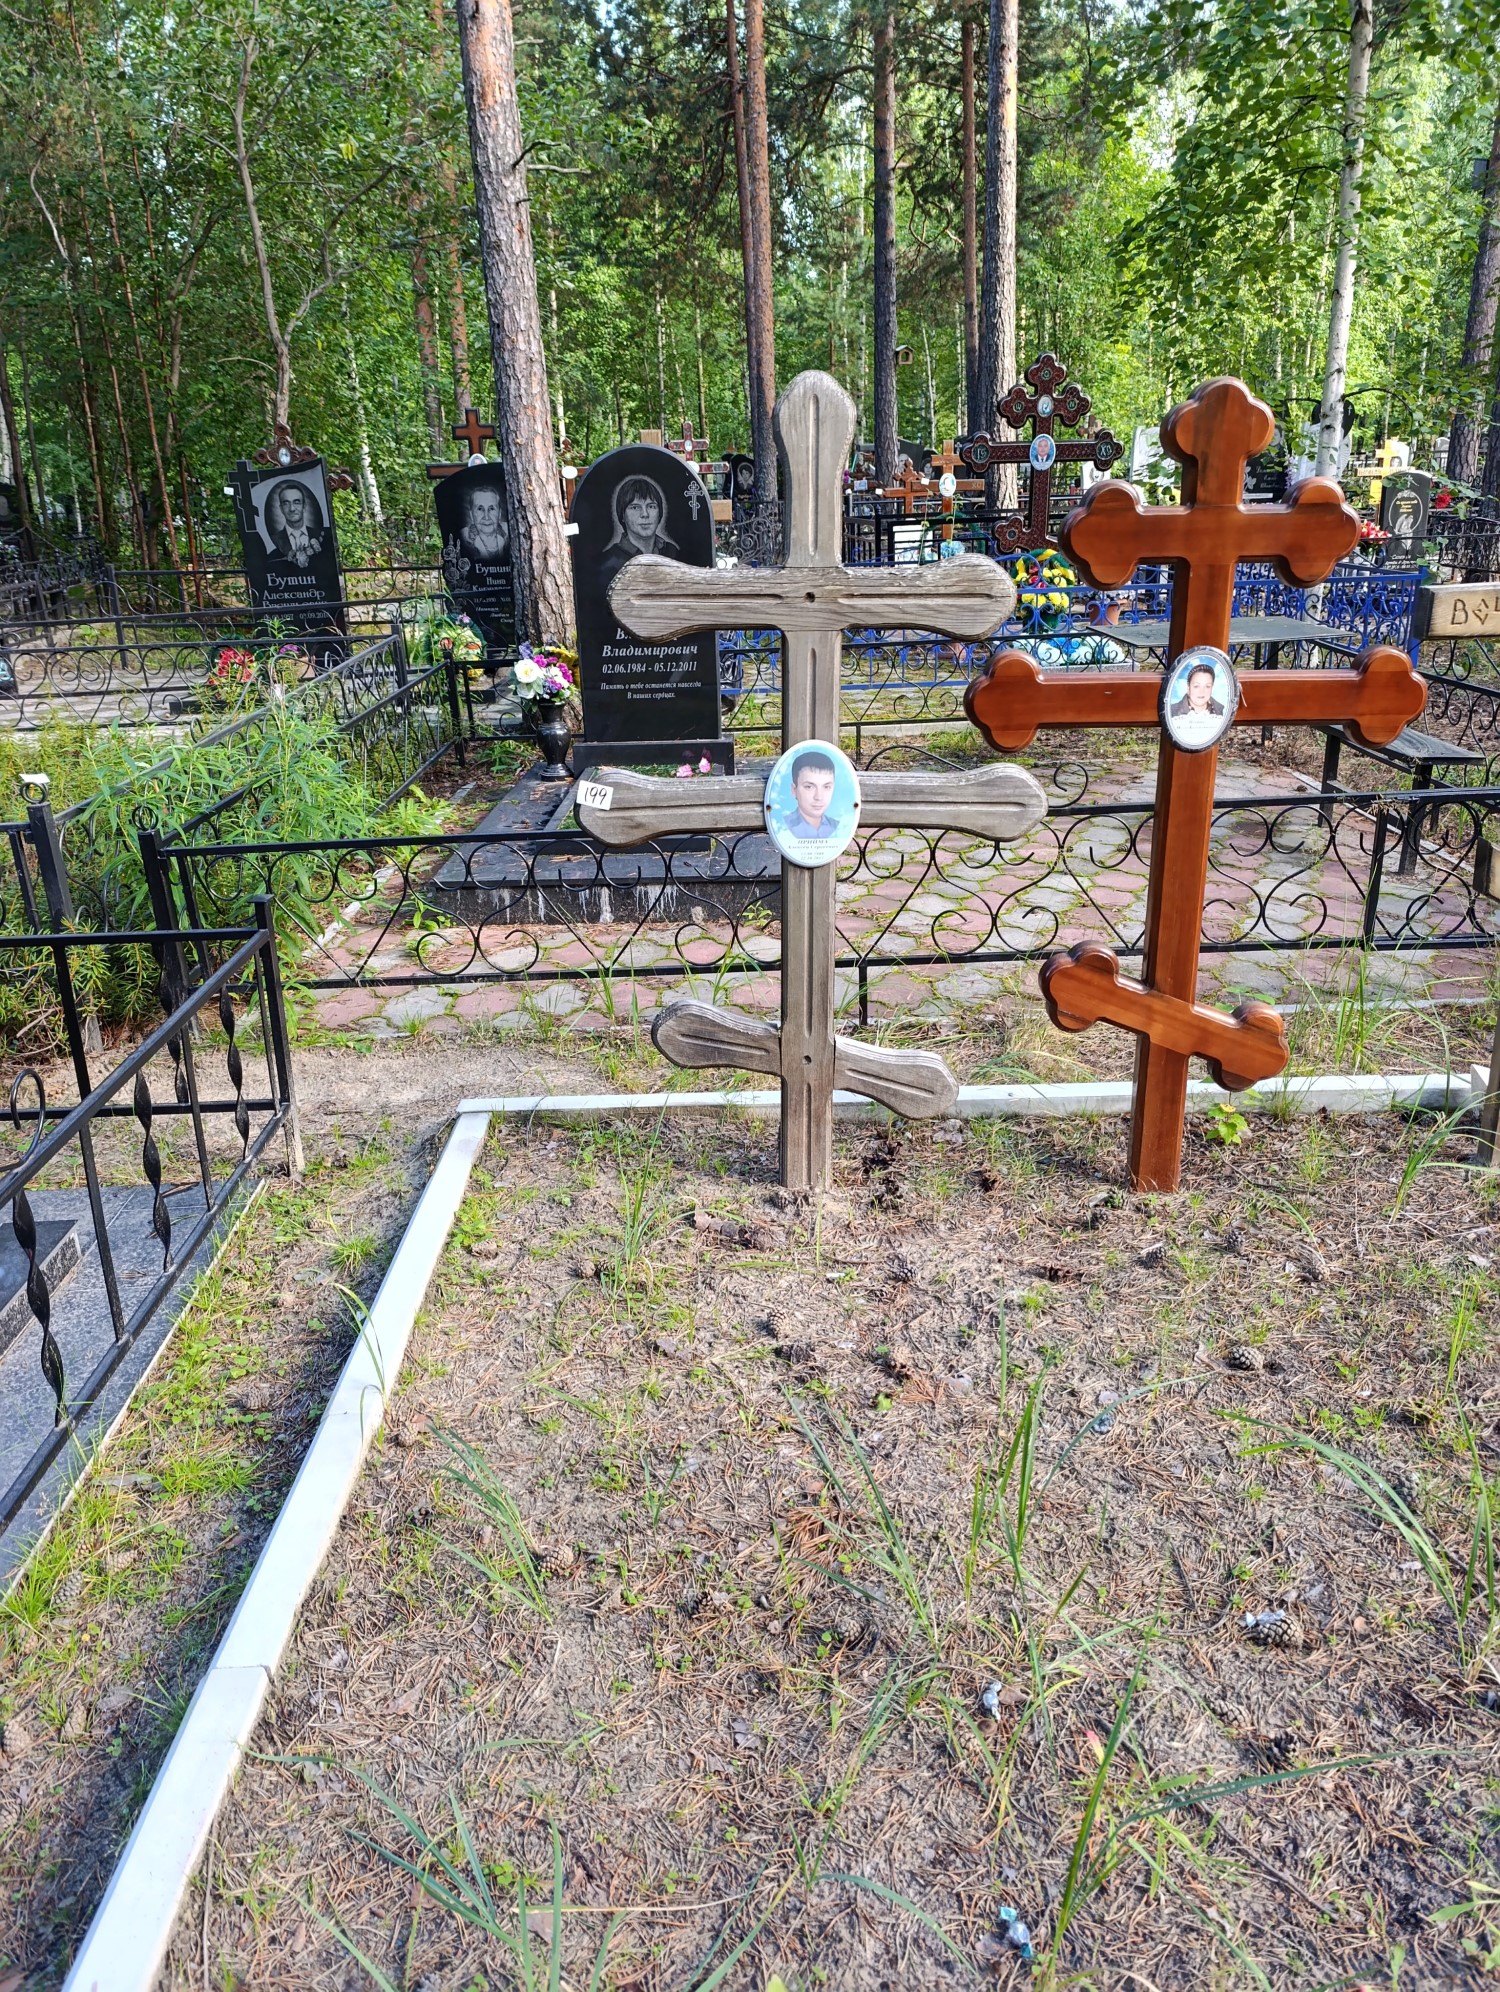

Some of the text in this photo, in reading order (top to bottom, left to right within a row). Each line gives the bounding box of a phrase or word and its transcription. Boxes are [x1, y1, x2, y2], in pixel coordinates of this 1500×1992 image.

[266, 572, 317, 590] Бутин
[263, 588, 326, 601] Александр
[602, 645, 698, 658] Владимирович
[602, 663, 647, 674] 02.06.1984
[654, 661, 698, 673] 05.12.2011
[600, 682, 625, 690] Память
[584, 786, 608, 806] 199
